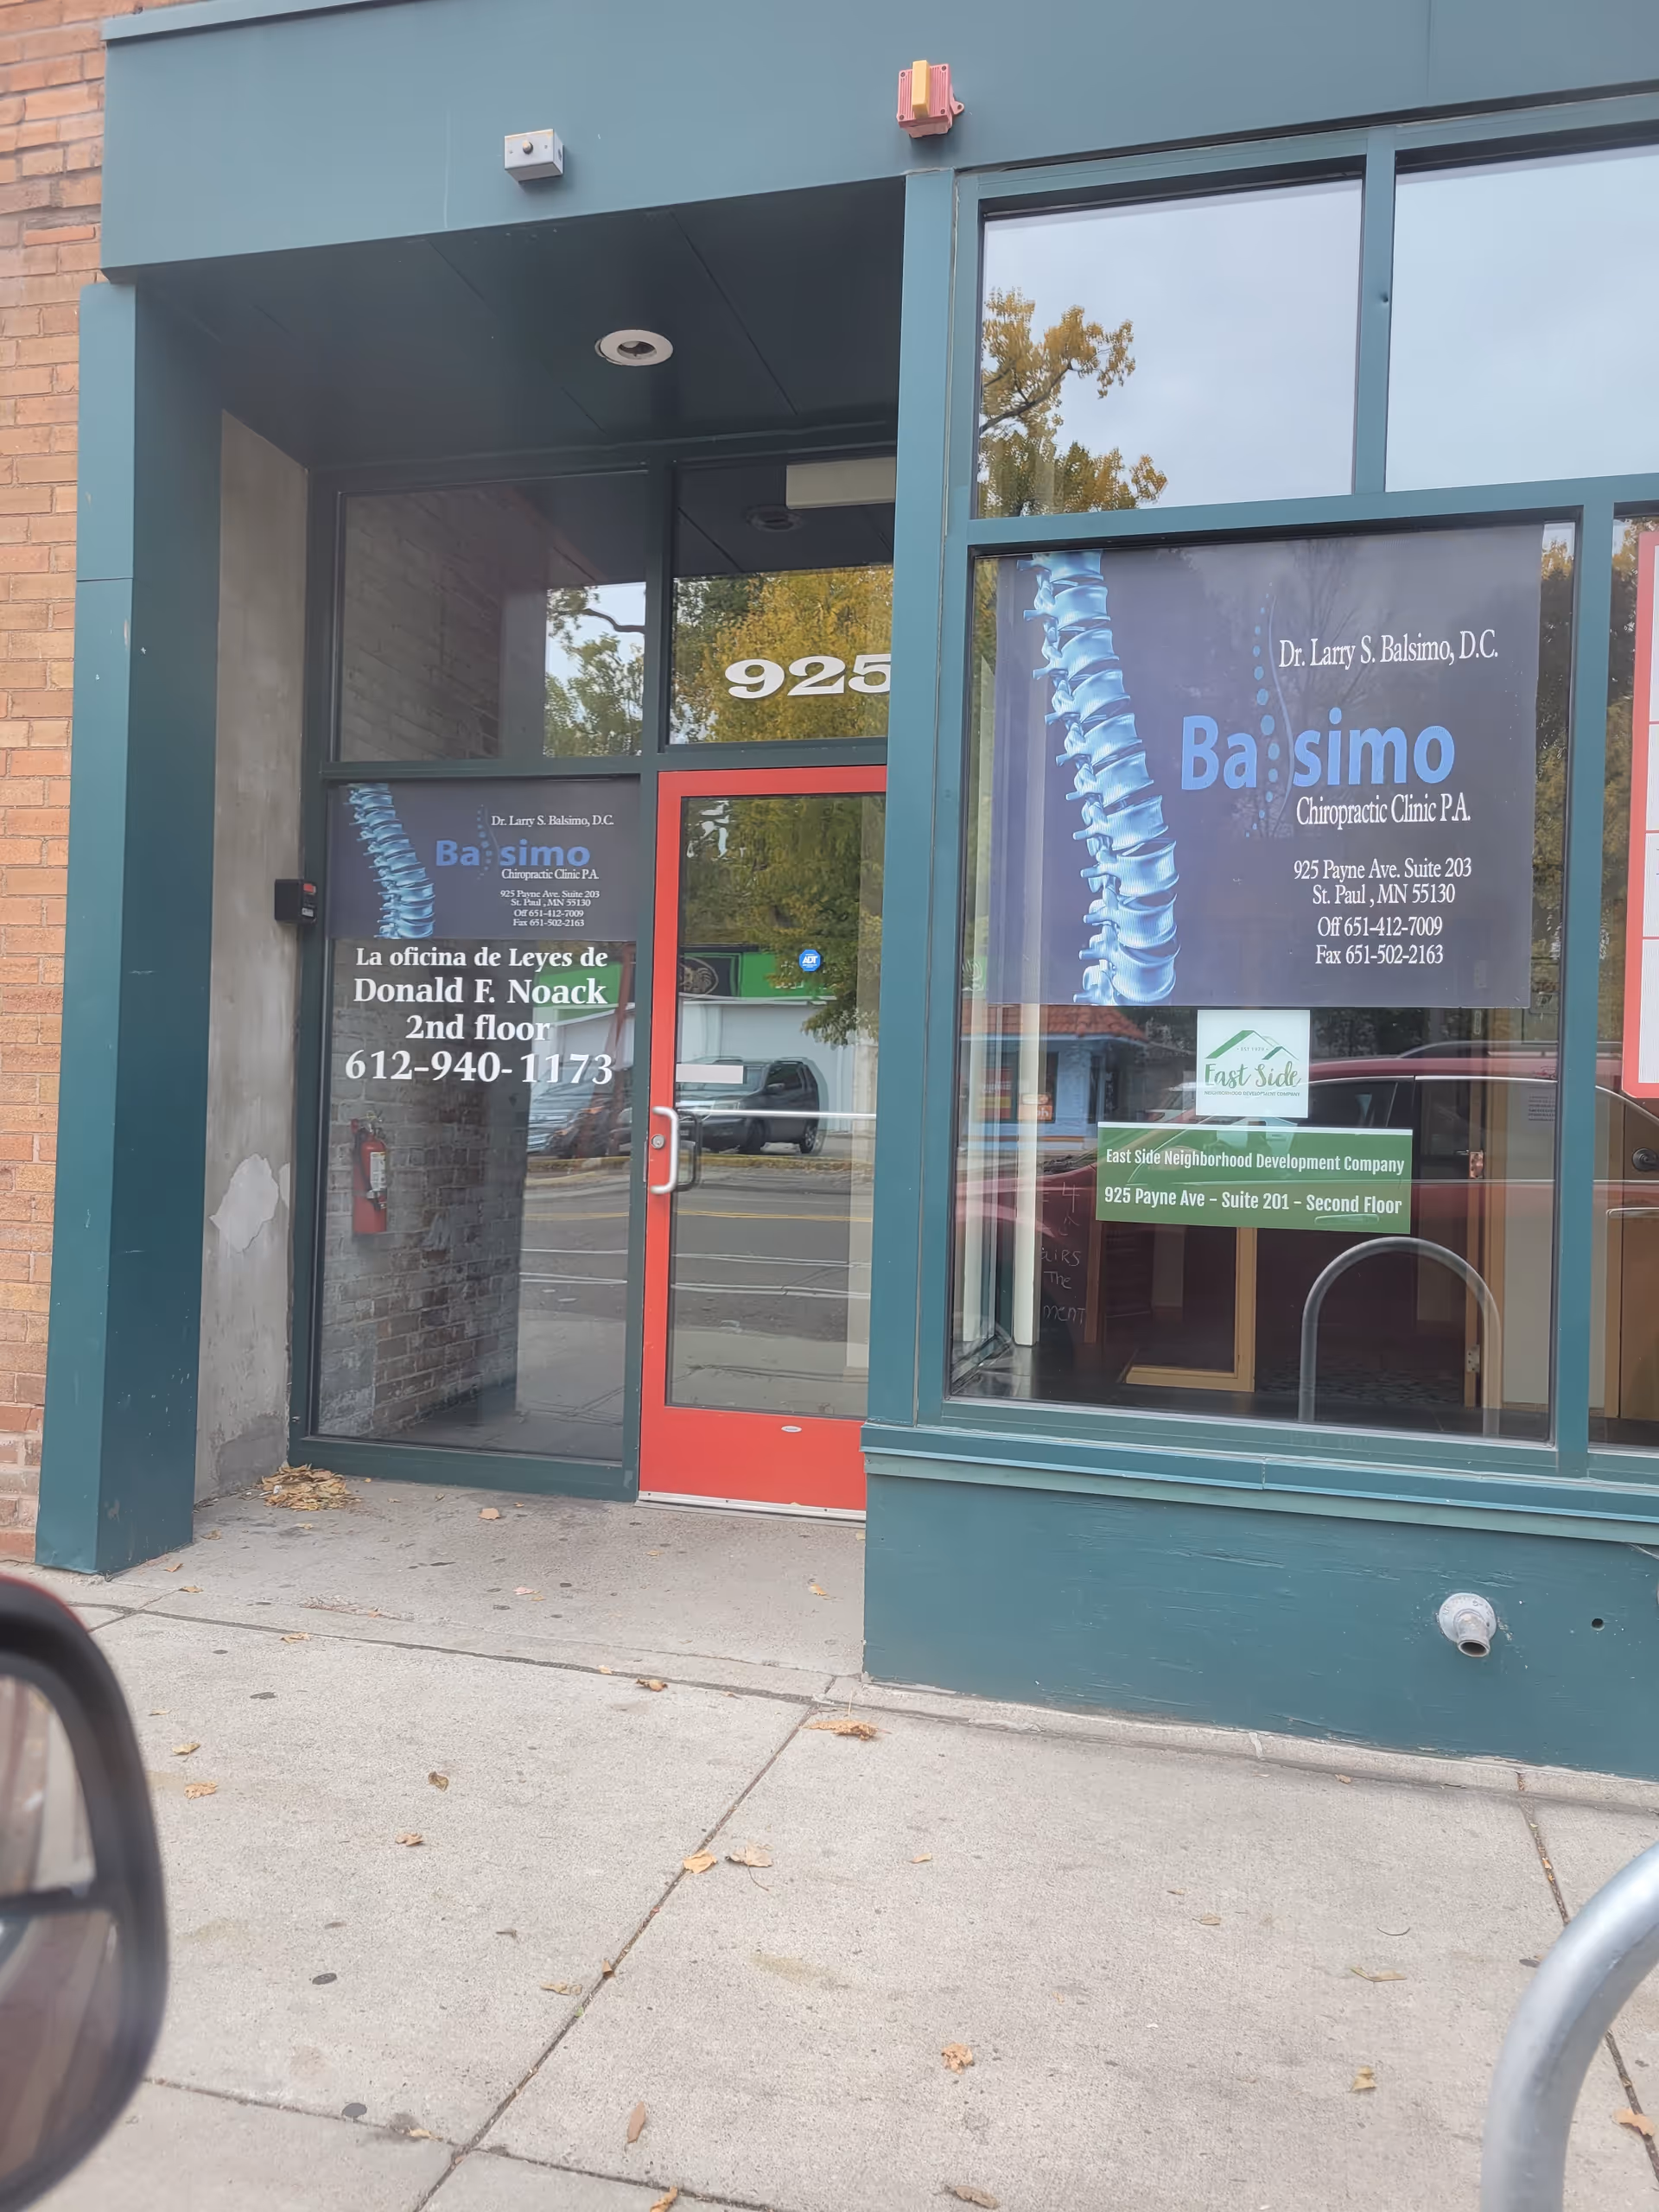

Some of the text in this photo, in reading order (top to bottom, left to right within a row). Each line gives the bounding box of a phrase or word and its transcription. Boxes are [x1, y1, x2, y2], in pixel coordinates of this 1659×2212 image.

[1279, 629, 1498, 671] Dr. Larry S. Balsimo, D.C.
[725, 653, 892, 699] 925
[491, 815, 614, 827] Dr. Larry S. Balsimo, D.C.
[1296, 791, 1471, 830] Chiropractic Clinic P.A.
[501, 868, 553, 880] Chiropractic
[554, 868, 581, 880] Clinic
[1294, 857, 1472, 883] 925 Payne Ave. Suite 203
[517, 890, 541, 899] Payne
[584, 890, 601, 899] 203
[566, 899, 591, 907] 55130
[1313, 884, 1331, 905] St.
[1334, 883, 1366, 905] Paul
[1376, 883, 1408, 904] MN
[1412, 883, 1456, 904] 55130
[528, 909, 584, 918] 651-412-7009
[529, 918, 585, 927] 651-502-2163
[1318, 915, 1443, 937] Off 651-412-7009
[355, 946, 608, 973] La oficina de Leyes de
[802, 956, 818, 964] ADT
[1315, 944, 1444, 965] Fax 651-502-2163
[353, 976, 608, 1005] Donald F. Noack
[405, 1014, 552, 1041] 2nd floor
[1205, 1060, 1302, 1089] East Side
[1106, 1148, 1405, 1176] East Side Neighborhood Development Company
[1104, 1186, 1132, 1205] 925
[1135, 1188, 1177, 1209] Payne
[1179, 1189, 1205, 1207] Ave
[1221, 1192, 1259, 1210] Suite
[1262, 1192, 1290, 1211] 201
[1306, 1193, 1359, 1213] Second
[1363, 1195, 1402, 1215] Floor
